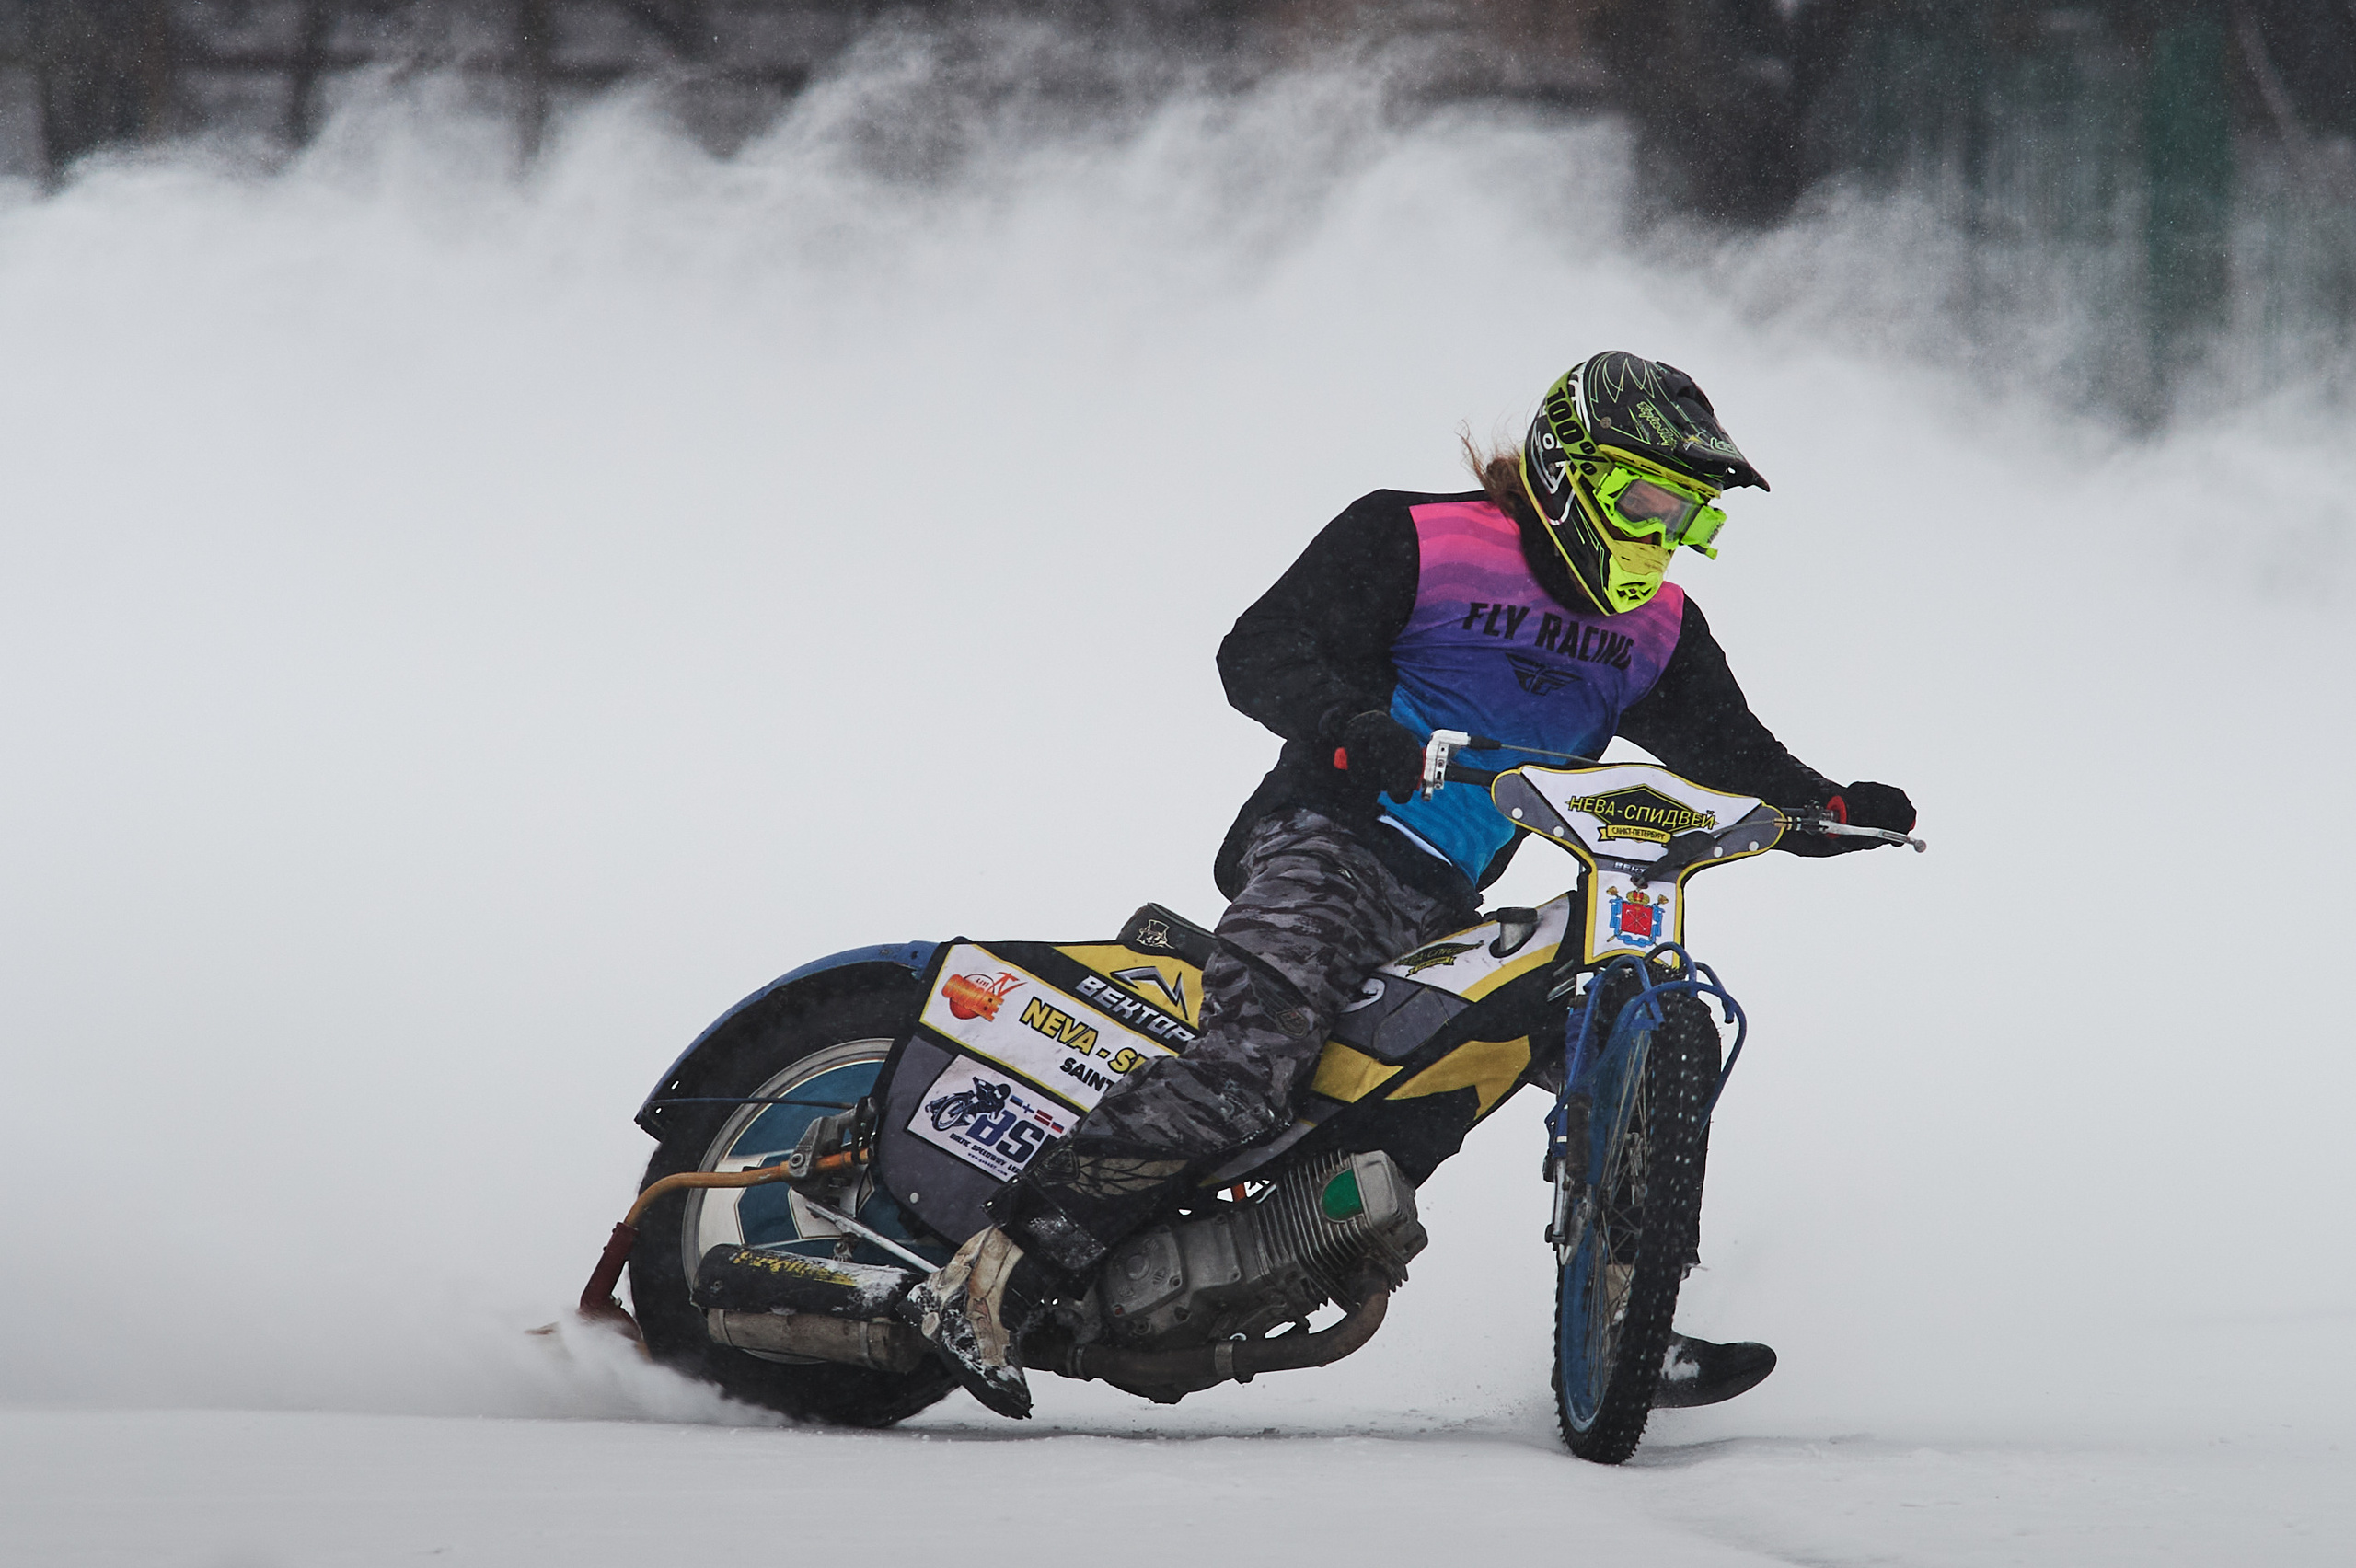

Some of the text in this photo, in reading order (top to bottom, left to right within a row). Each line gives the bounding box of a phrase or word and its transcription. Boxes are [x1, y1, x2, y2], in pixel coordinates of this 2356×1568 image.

[1547, 387, 1609, 476] 100%
[1462, 601, 1634, 670] FLY RACING
[1567, 795, 1716, 830] НЕВА-СПИДВЕЙ
[1019, 996, 1099, 1056] NEVA
[1059, 1057, 1115, 1094] SAINT
[971, 1144, 1007, 1166] SPEEDWAY
